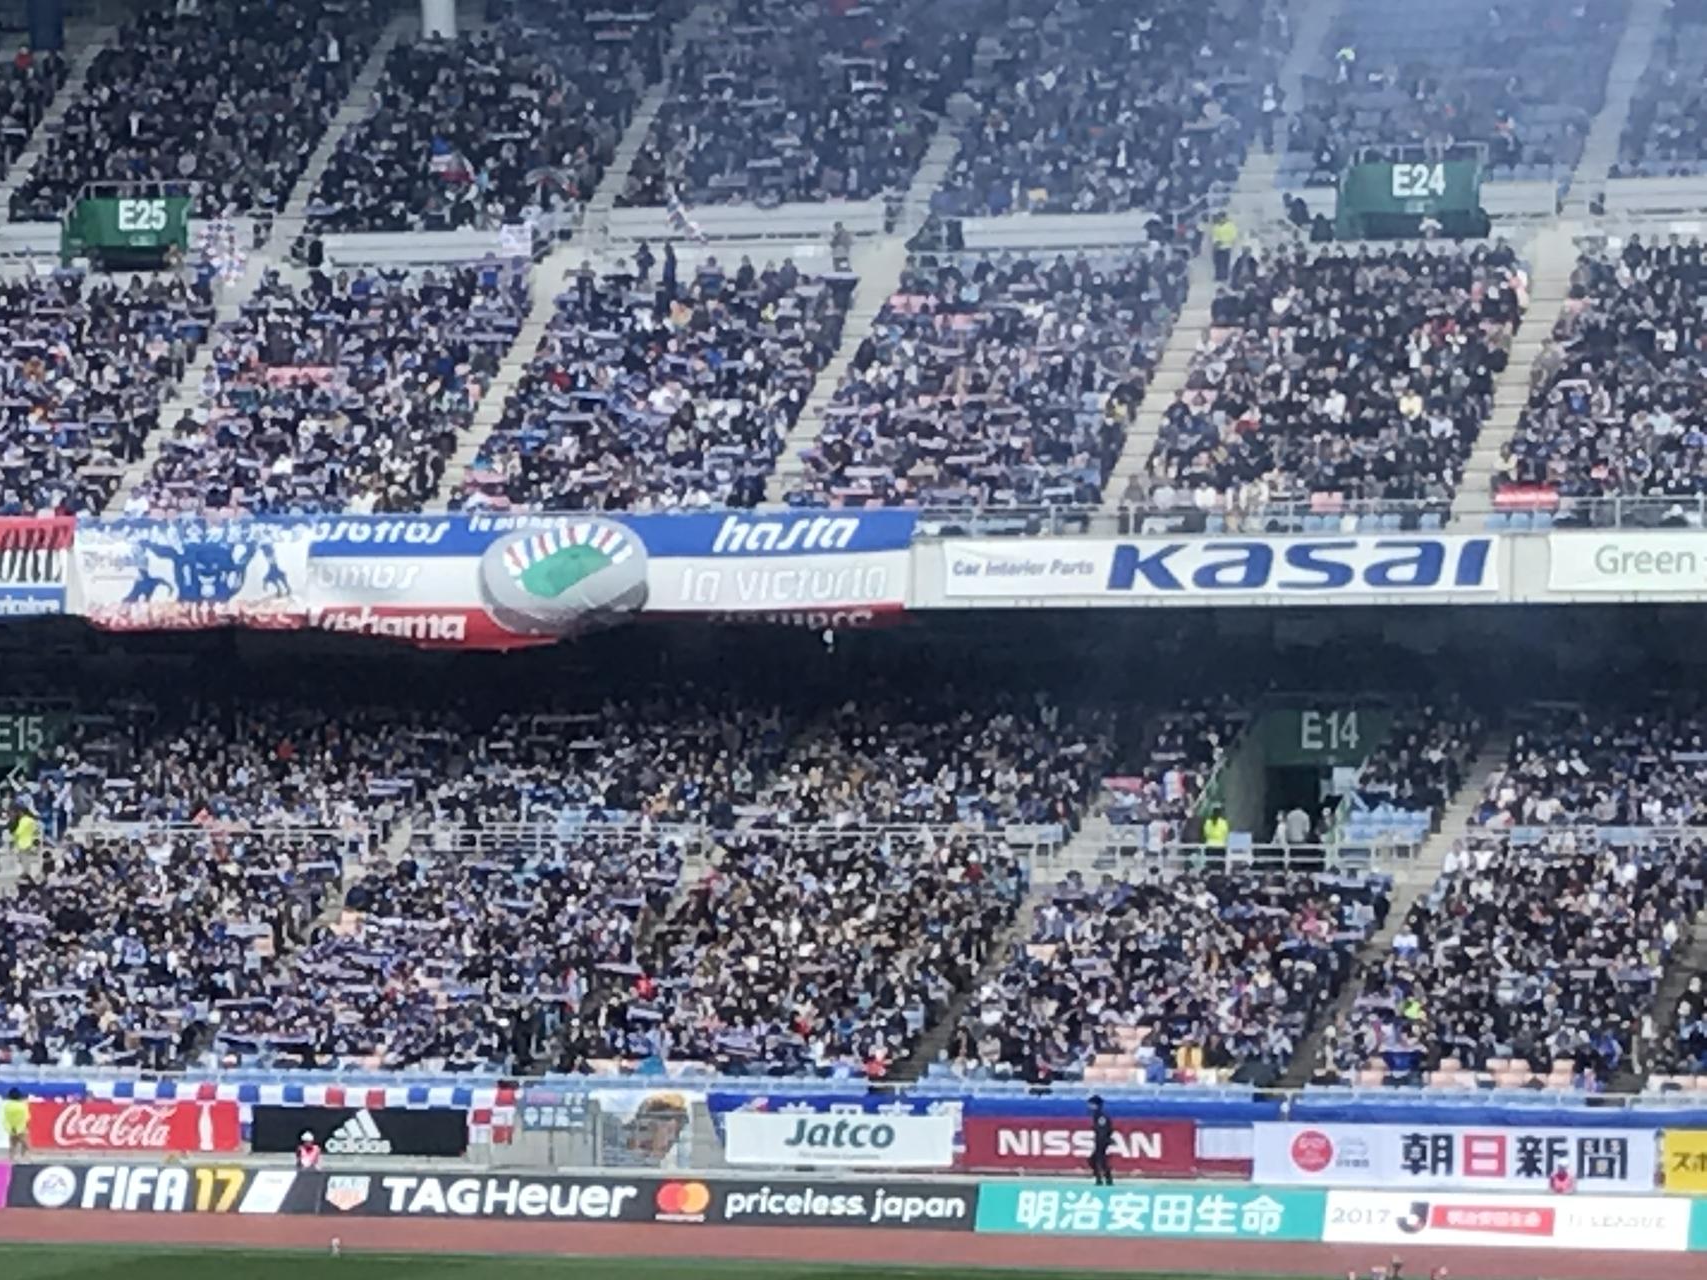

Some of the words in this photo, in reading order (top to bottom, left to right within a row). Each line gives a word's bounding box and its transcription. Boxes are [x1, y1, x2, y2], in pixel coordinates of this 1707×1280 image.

[1392, 164, 1445, 197] E24
[118, 200, 167, 231] E25
[712, 515, 861, 553] hasta
[1594, 544, 1695, 576] Green
[1300, 712, 1360, 751] E14
[325, 1138, 392, 1154] adidas
[784, 1118, 895, 1149] Jatco
[997, 1129, 1162, 1159] NISSAN
[1400, 1133, 1629, 1180] 朝日新聞
[81, 1166, 190, 1211] FIFA
[196, 1168, 246, 1212] 17
[725, 1187, 866, 1219] priceless
[871, 1188, 965, 1222] japan
[1017, 1191, 1286, 1235] 明治安田生命
[1330, 1206, 1392, 1225] 2017
